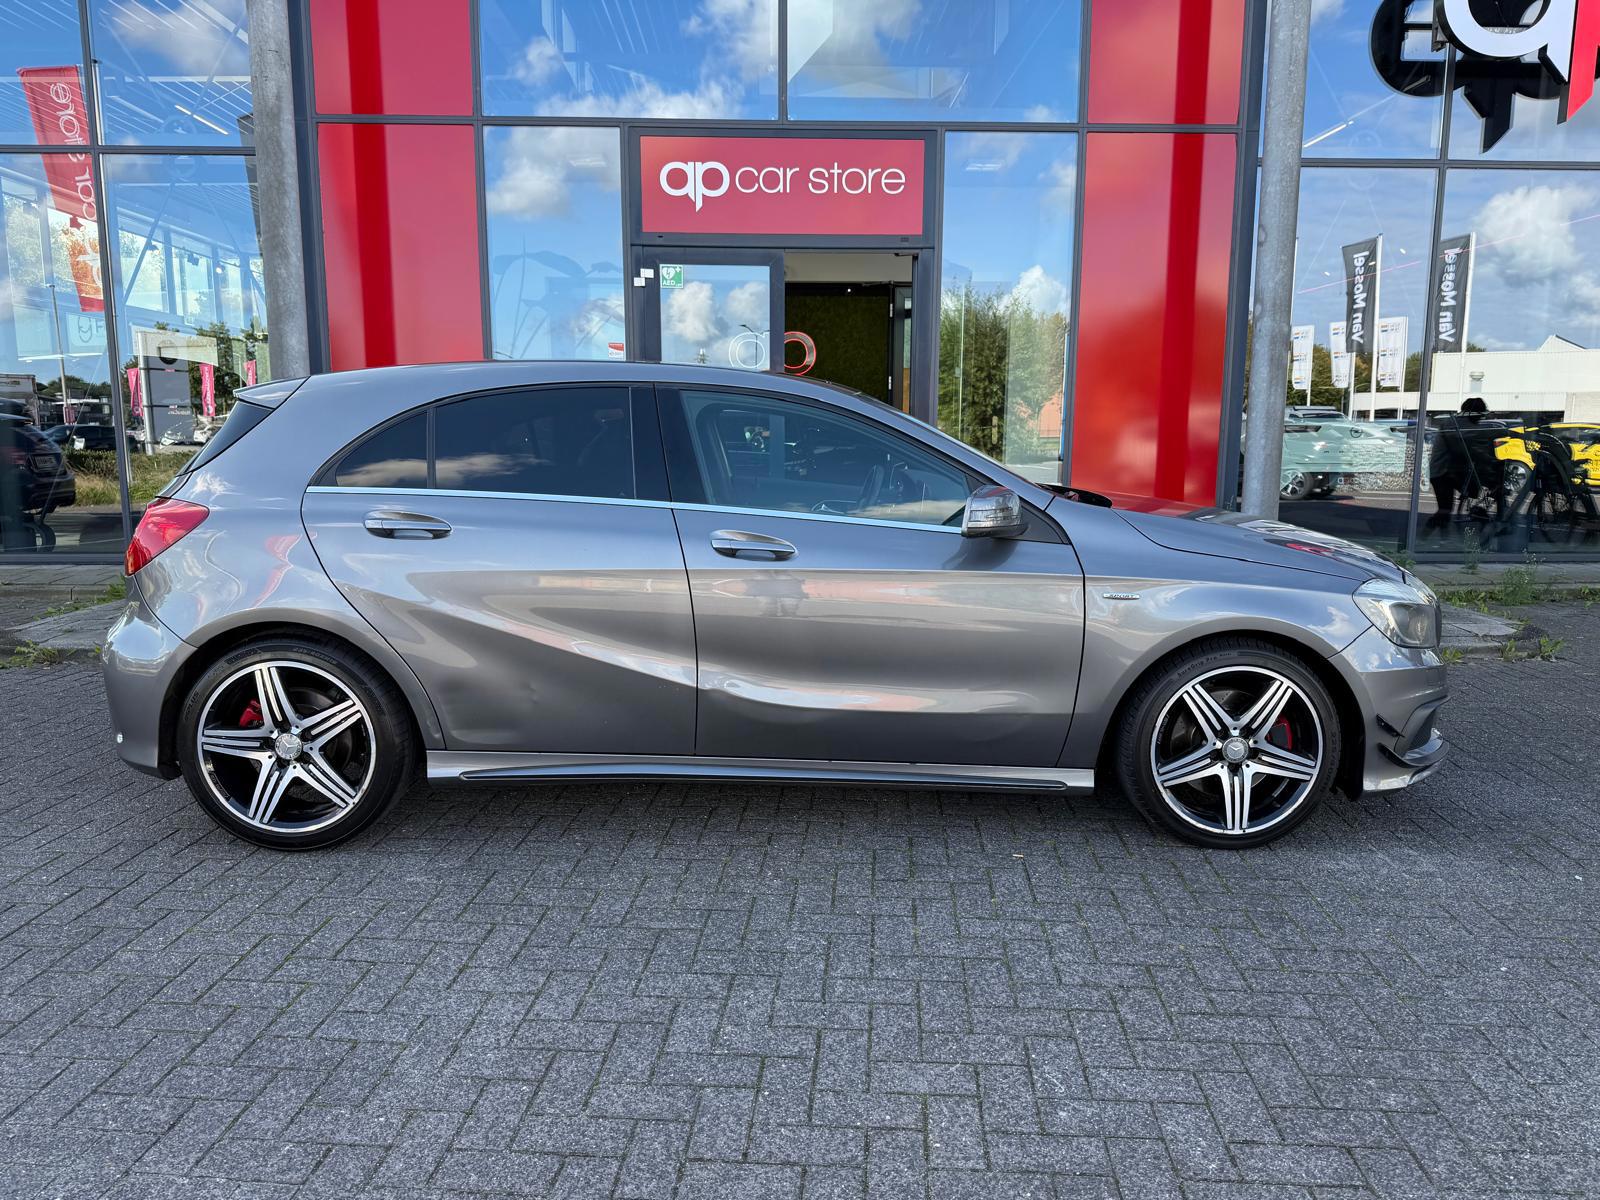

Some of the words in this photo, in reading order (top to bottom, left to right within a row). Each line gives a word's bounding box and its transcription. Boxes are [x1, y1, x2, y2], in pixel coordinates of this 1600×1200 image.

[659, 160, 730, 212] ap
[735, 166, 799, 194] car
[808, 162, 906, 195] store
